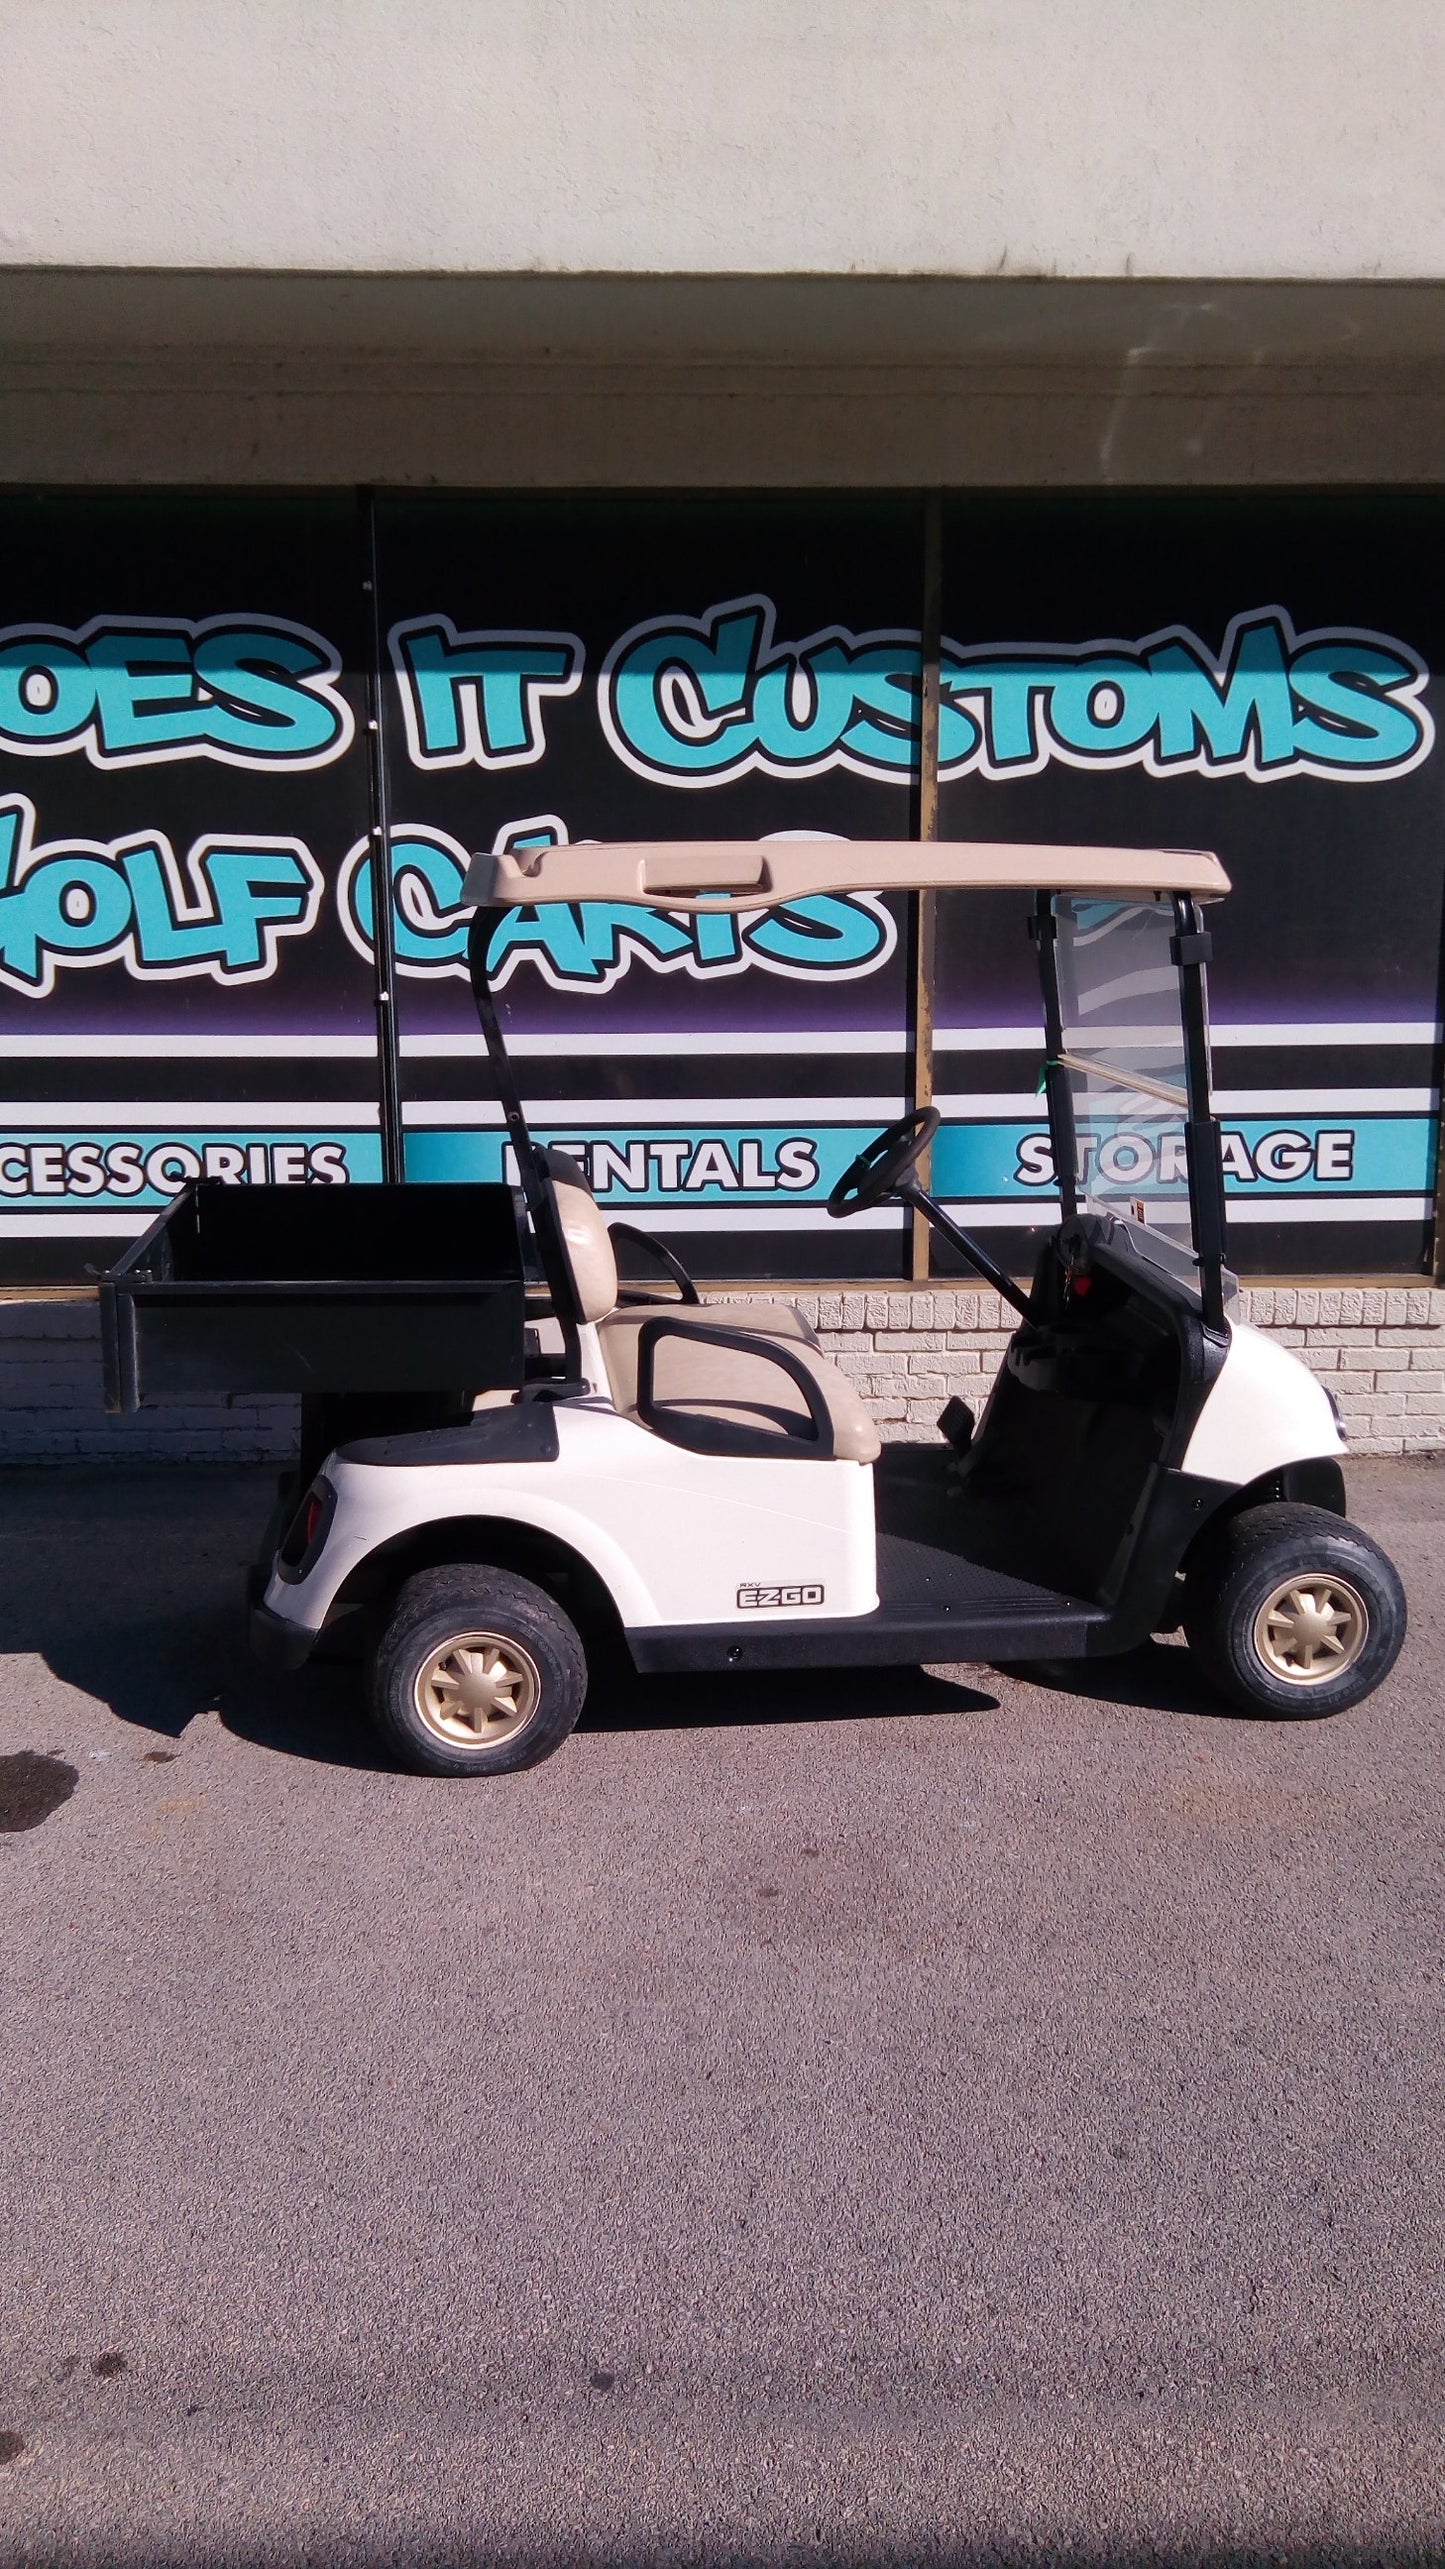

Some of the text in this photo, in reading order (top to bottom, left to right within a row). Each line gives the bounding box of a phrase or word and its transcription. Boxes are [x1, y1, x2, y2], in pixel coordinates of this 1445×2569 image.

[397, 623, 577, 759] IT
[606, 604, 1427, 779] CUSTOMS
[0, 803, 313, 988] OLF
[0, 1143, 349, 1196] CESSORIES
[1015, 1131, 1353, 1185] STORAGE
[737, 1585, 824, 1608] EZGO
